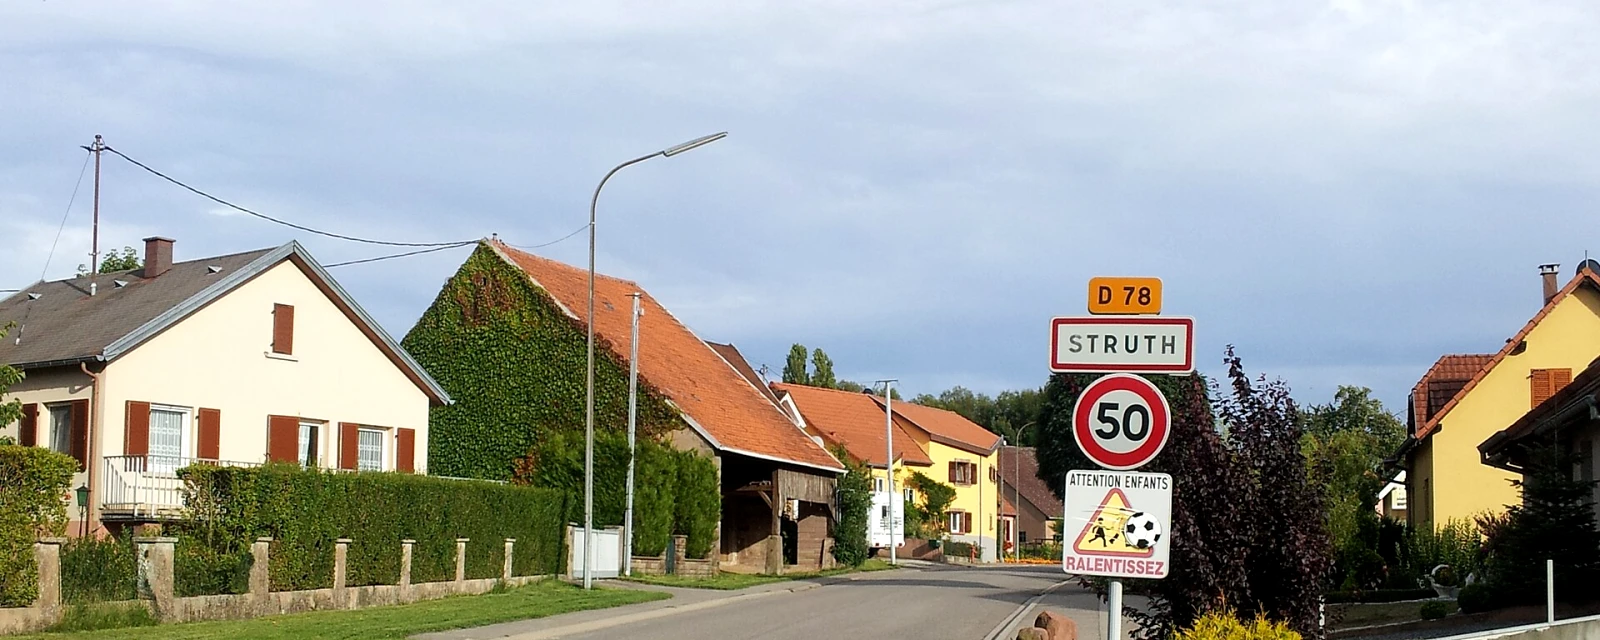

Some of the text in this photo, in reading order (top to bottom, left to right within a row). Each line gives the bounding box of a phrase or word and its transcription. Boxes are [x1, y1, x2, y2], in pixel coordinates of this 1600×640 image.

[1098, 286, 1151, 305] D 78
[1068, 334, 1176, 354] STRUTH
[1094, 402, 1149, 441] 50
[1069, 473, 1169, 489] ATTENTION ENFANTS
[1066, 556, 1164, 575] RALENTISSEZ
